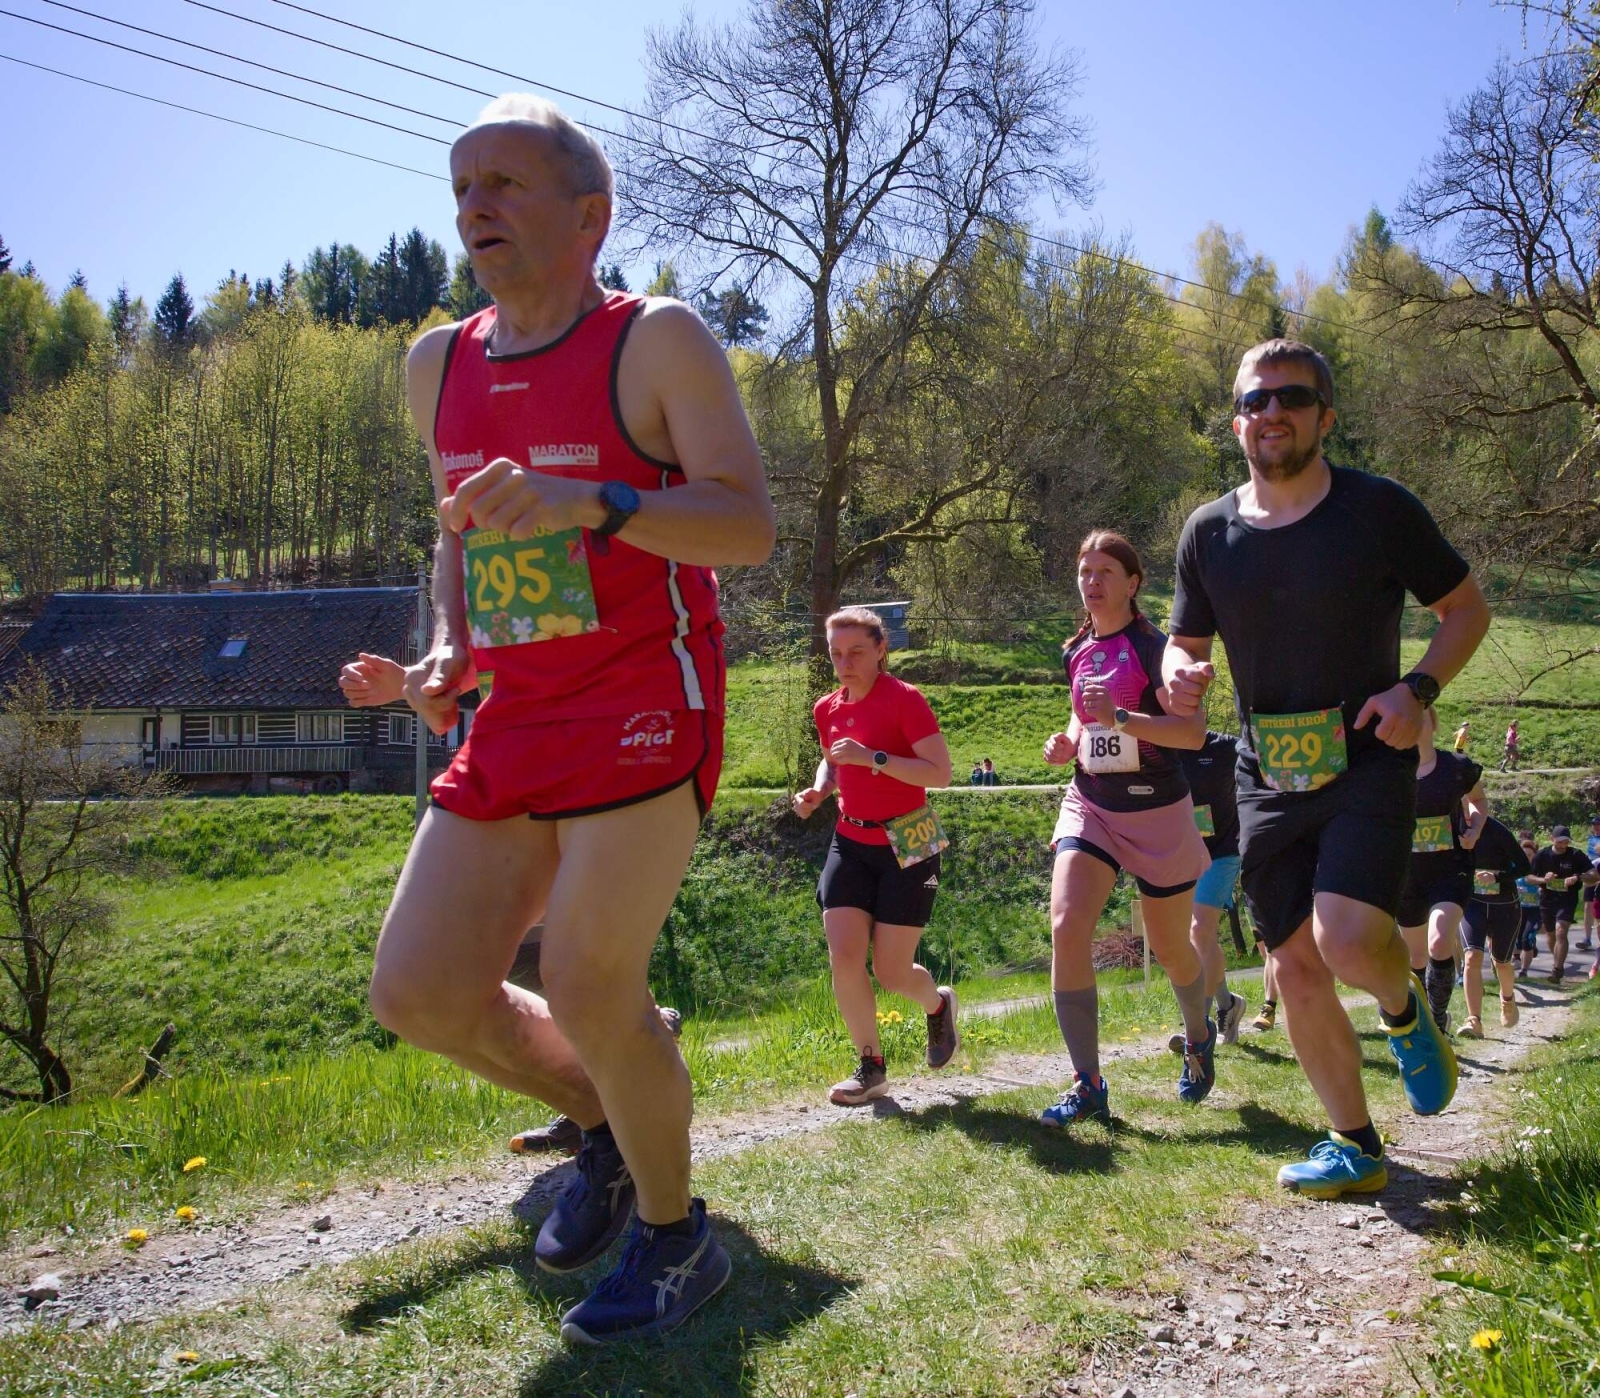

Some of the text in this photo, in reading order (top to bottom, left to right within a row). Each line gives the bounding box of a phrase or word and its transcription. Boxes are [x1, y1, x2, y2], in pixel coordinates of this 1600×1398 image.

[528, 444, 599, 459] MARATON
[473, 548, 552, 612] 295
[1090, 735, 1121, 758] 186
[1265, 731, 1322, 768] 229
[903, 817, 937, 850] 209
[1413, 825, 1441, 843] 197
